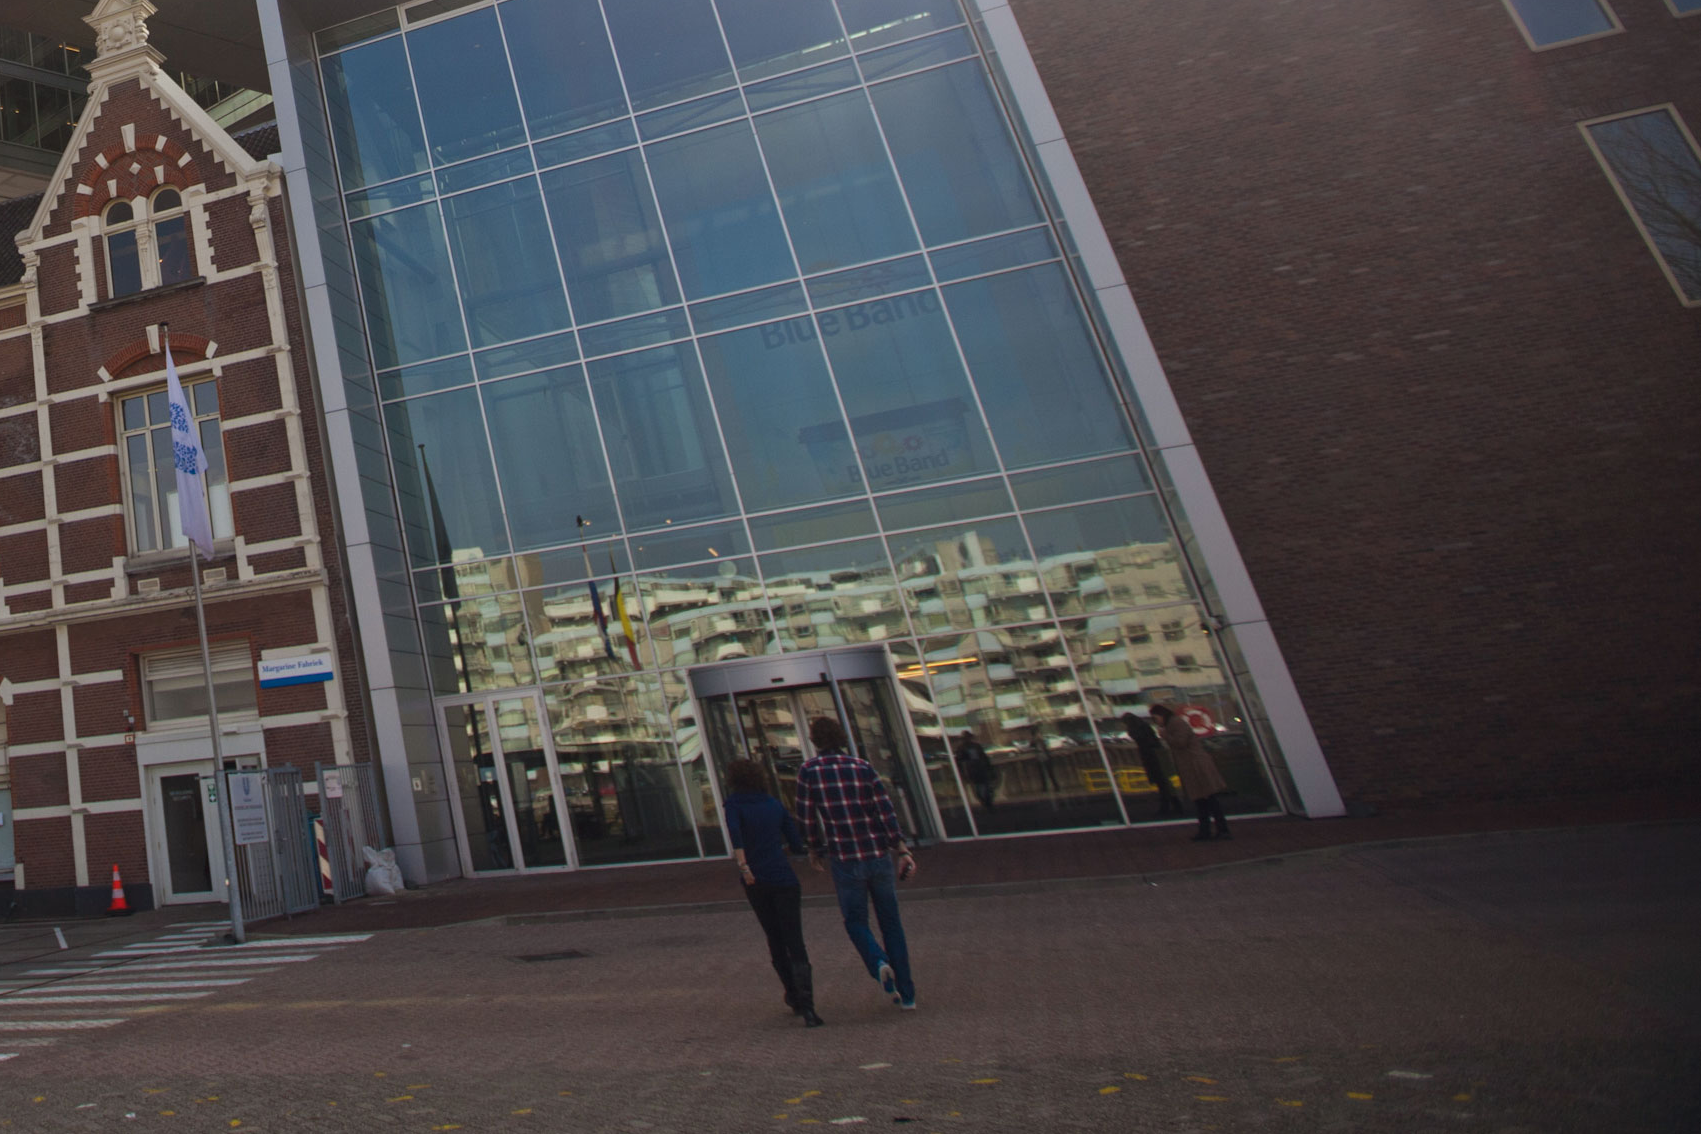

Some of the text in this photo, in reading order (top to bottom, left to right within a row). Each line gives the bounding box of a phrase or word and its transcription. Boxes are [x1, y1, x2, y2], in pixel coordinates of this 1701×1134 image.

[846, 449, 950, 483] Bue Band
[261, 658, 324, 674] Margarine Fabriek
